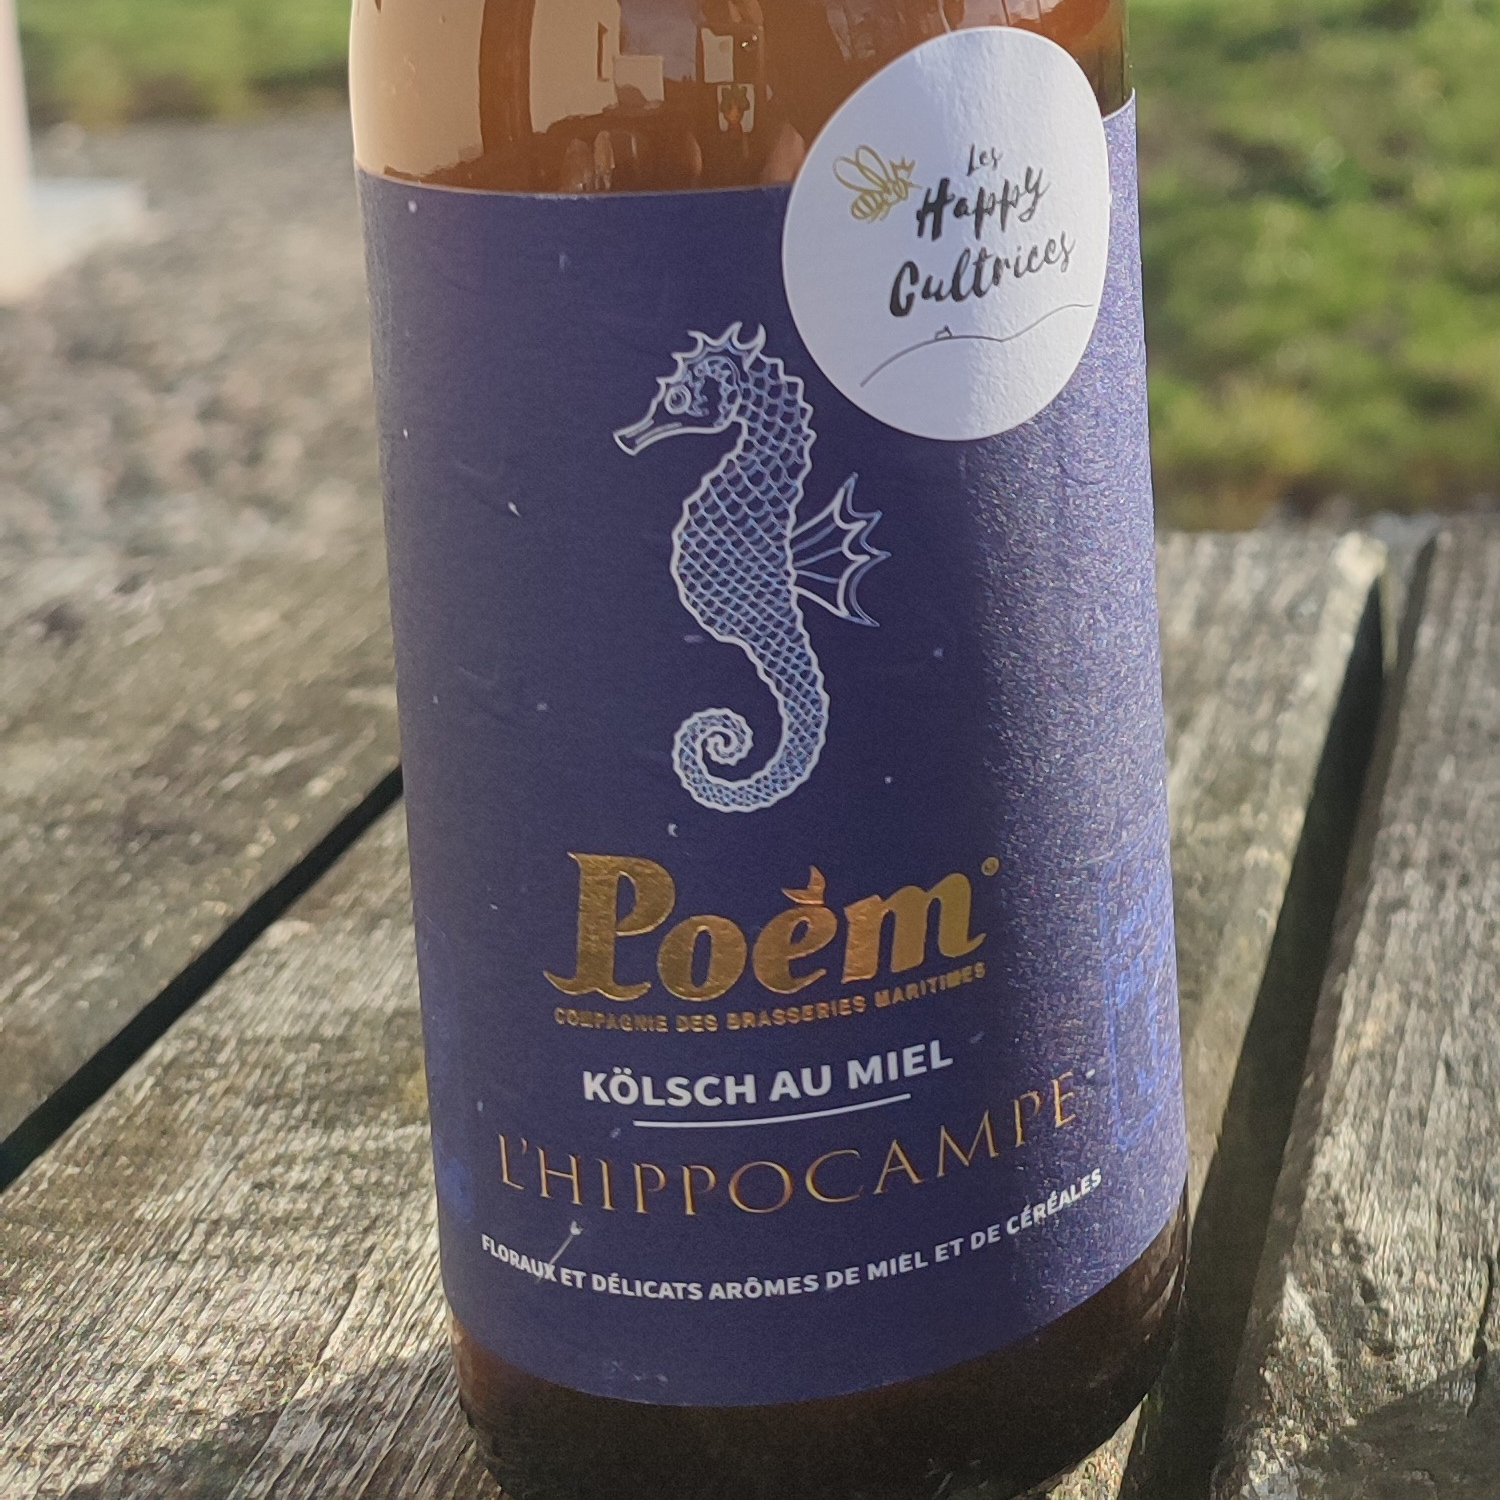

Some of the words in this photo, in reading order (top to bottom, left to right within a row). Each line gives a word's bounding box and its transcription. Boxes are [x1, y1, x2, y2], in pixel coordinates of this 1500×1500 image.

[967, 144, 1003, 177] Les
[916, 166, 1049, 241] Happy
[889, 231, 1077, 318] Cultrices
[553, 1006, 669, 1033] COMPAGNIE
[676, 1014, 718, 1033] DES
[727, 995, 866, 1030] BRASSERIES
[874, 961, 987, 1008] MARITIMES
[582, 1066, 758, 1107] KÖLSCH
[769, 1064, 833, 1102] AU
[847, 1039, 954, 1090] MIEL
[498, 1068, 1077, 1215] L'HIPPOCAMPE
[481, 1234, 558, 1283] FLORAUX
[560, 1267, 587, 1290] ET
[592, 1272, 703, 1301] DÉLICATS
[708, 1275, 820, 1300] ARÔMES
[825, 1266, 861, 1289] DE
[867, 1252, 929, 1282] MIEL
[934, 1238, 965, 1263] ET
[970, 1223, 1001, 1250] DE
[1006, 1167, 1102, 1236] CÉRÉALES
